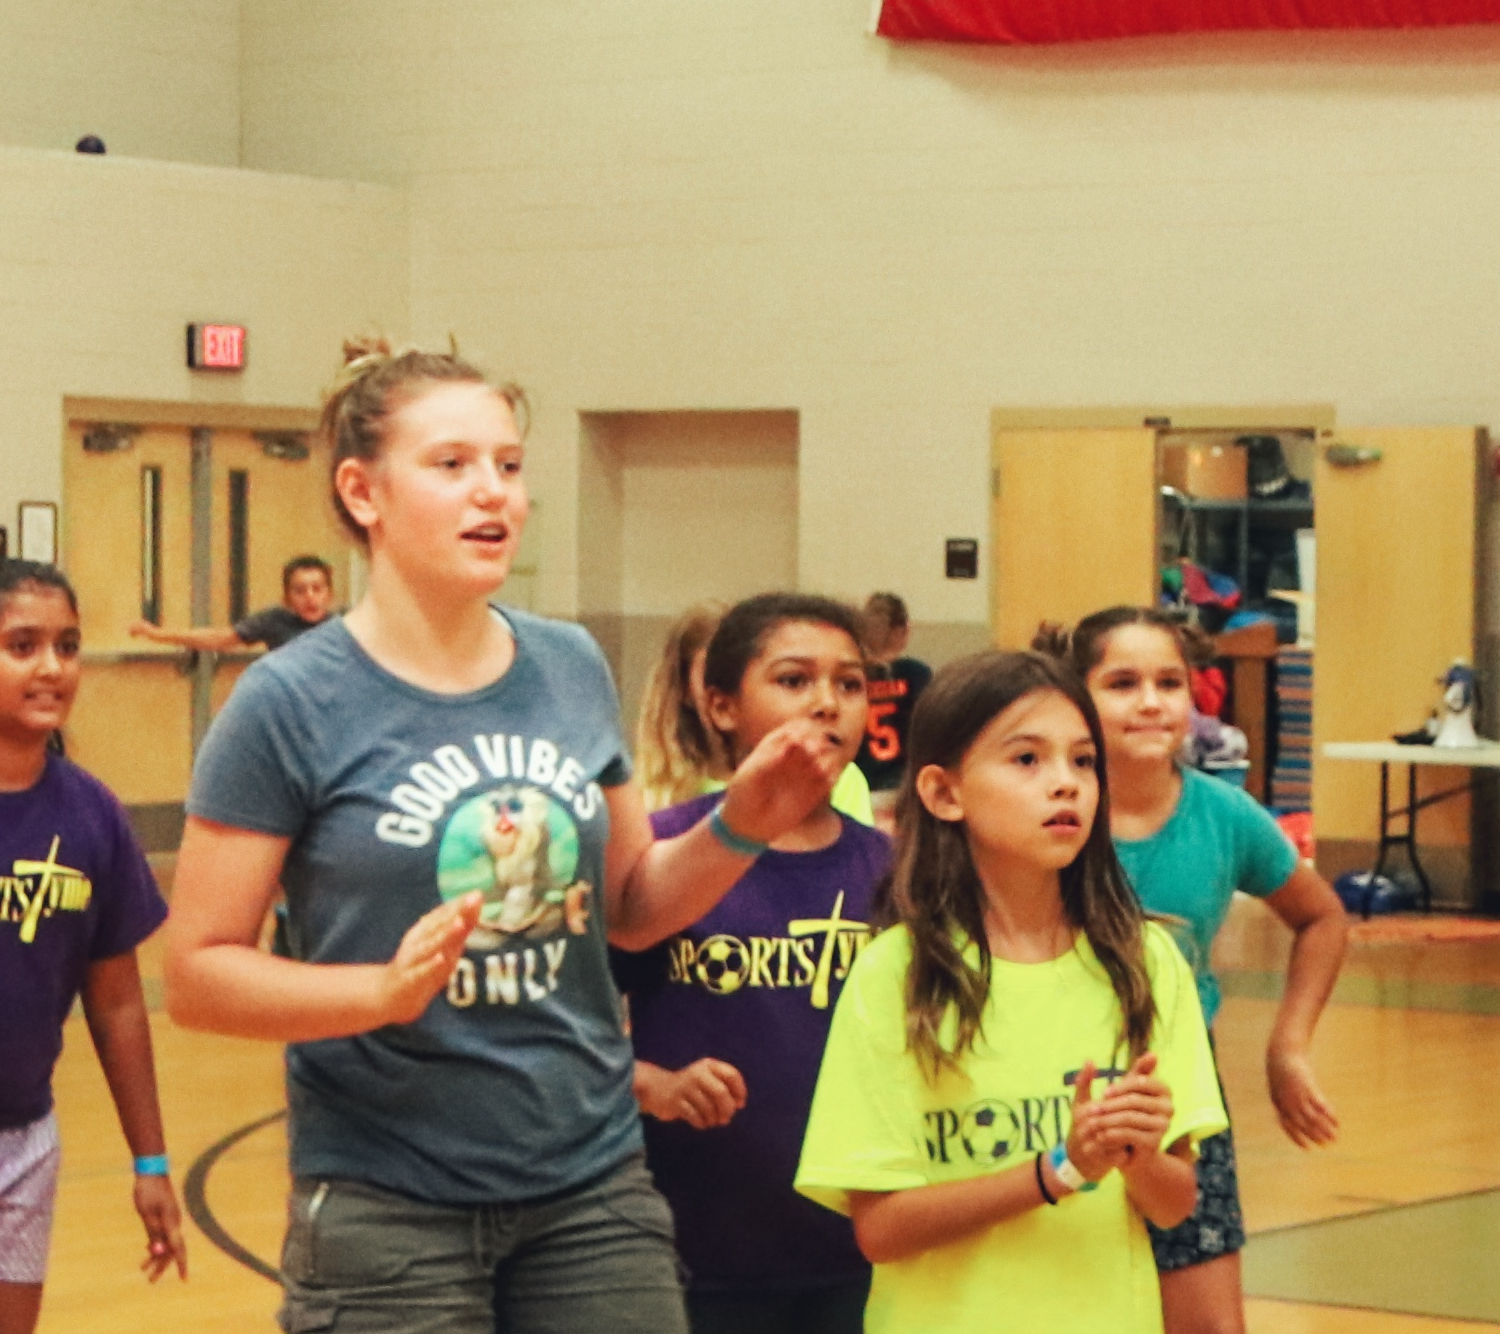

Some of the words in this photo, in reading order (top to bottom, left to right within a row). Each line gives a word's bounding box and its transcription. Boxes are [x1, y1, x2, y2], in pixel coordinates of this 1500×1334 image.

[205, 328, 243, 364] EXIT
[375, 743, 481, 848] GOOD
[473, 733, 602, 821] VIBES
[447, 938, 568, 1008] ONLY
